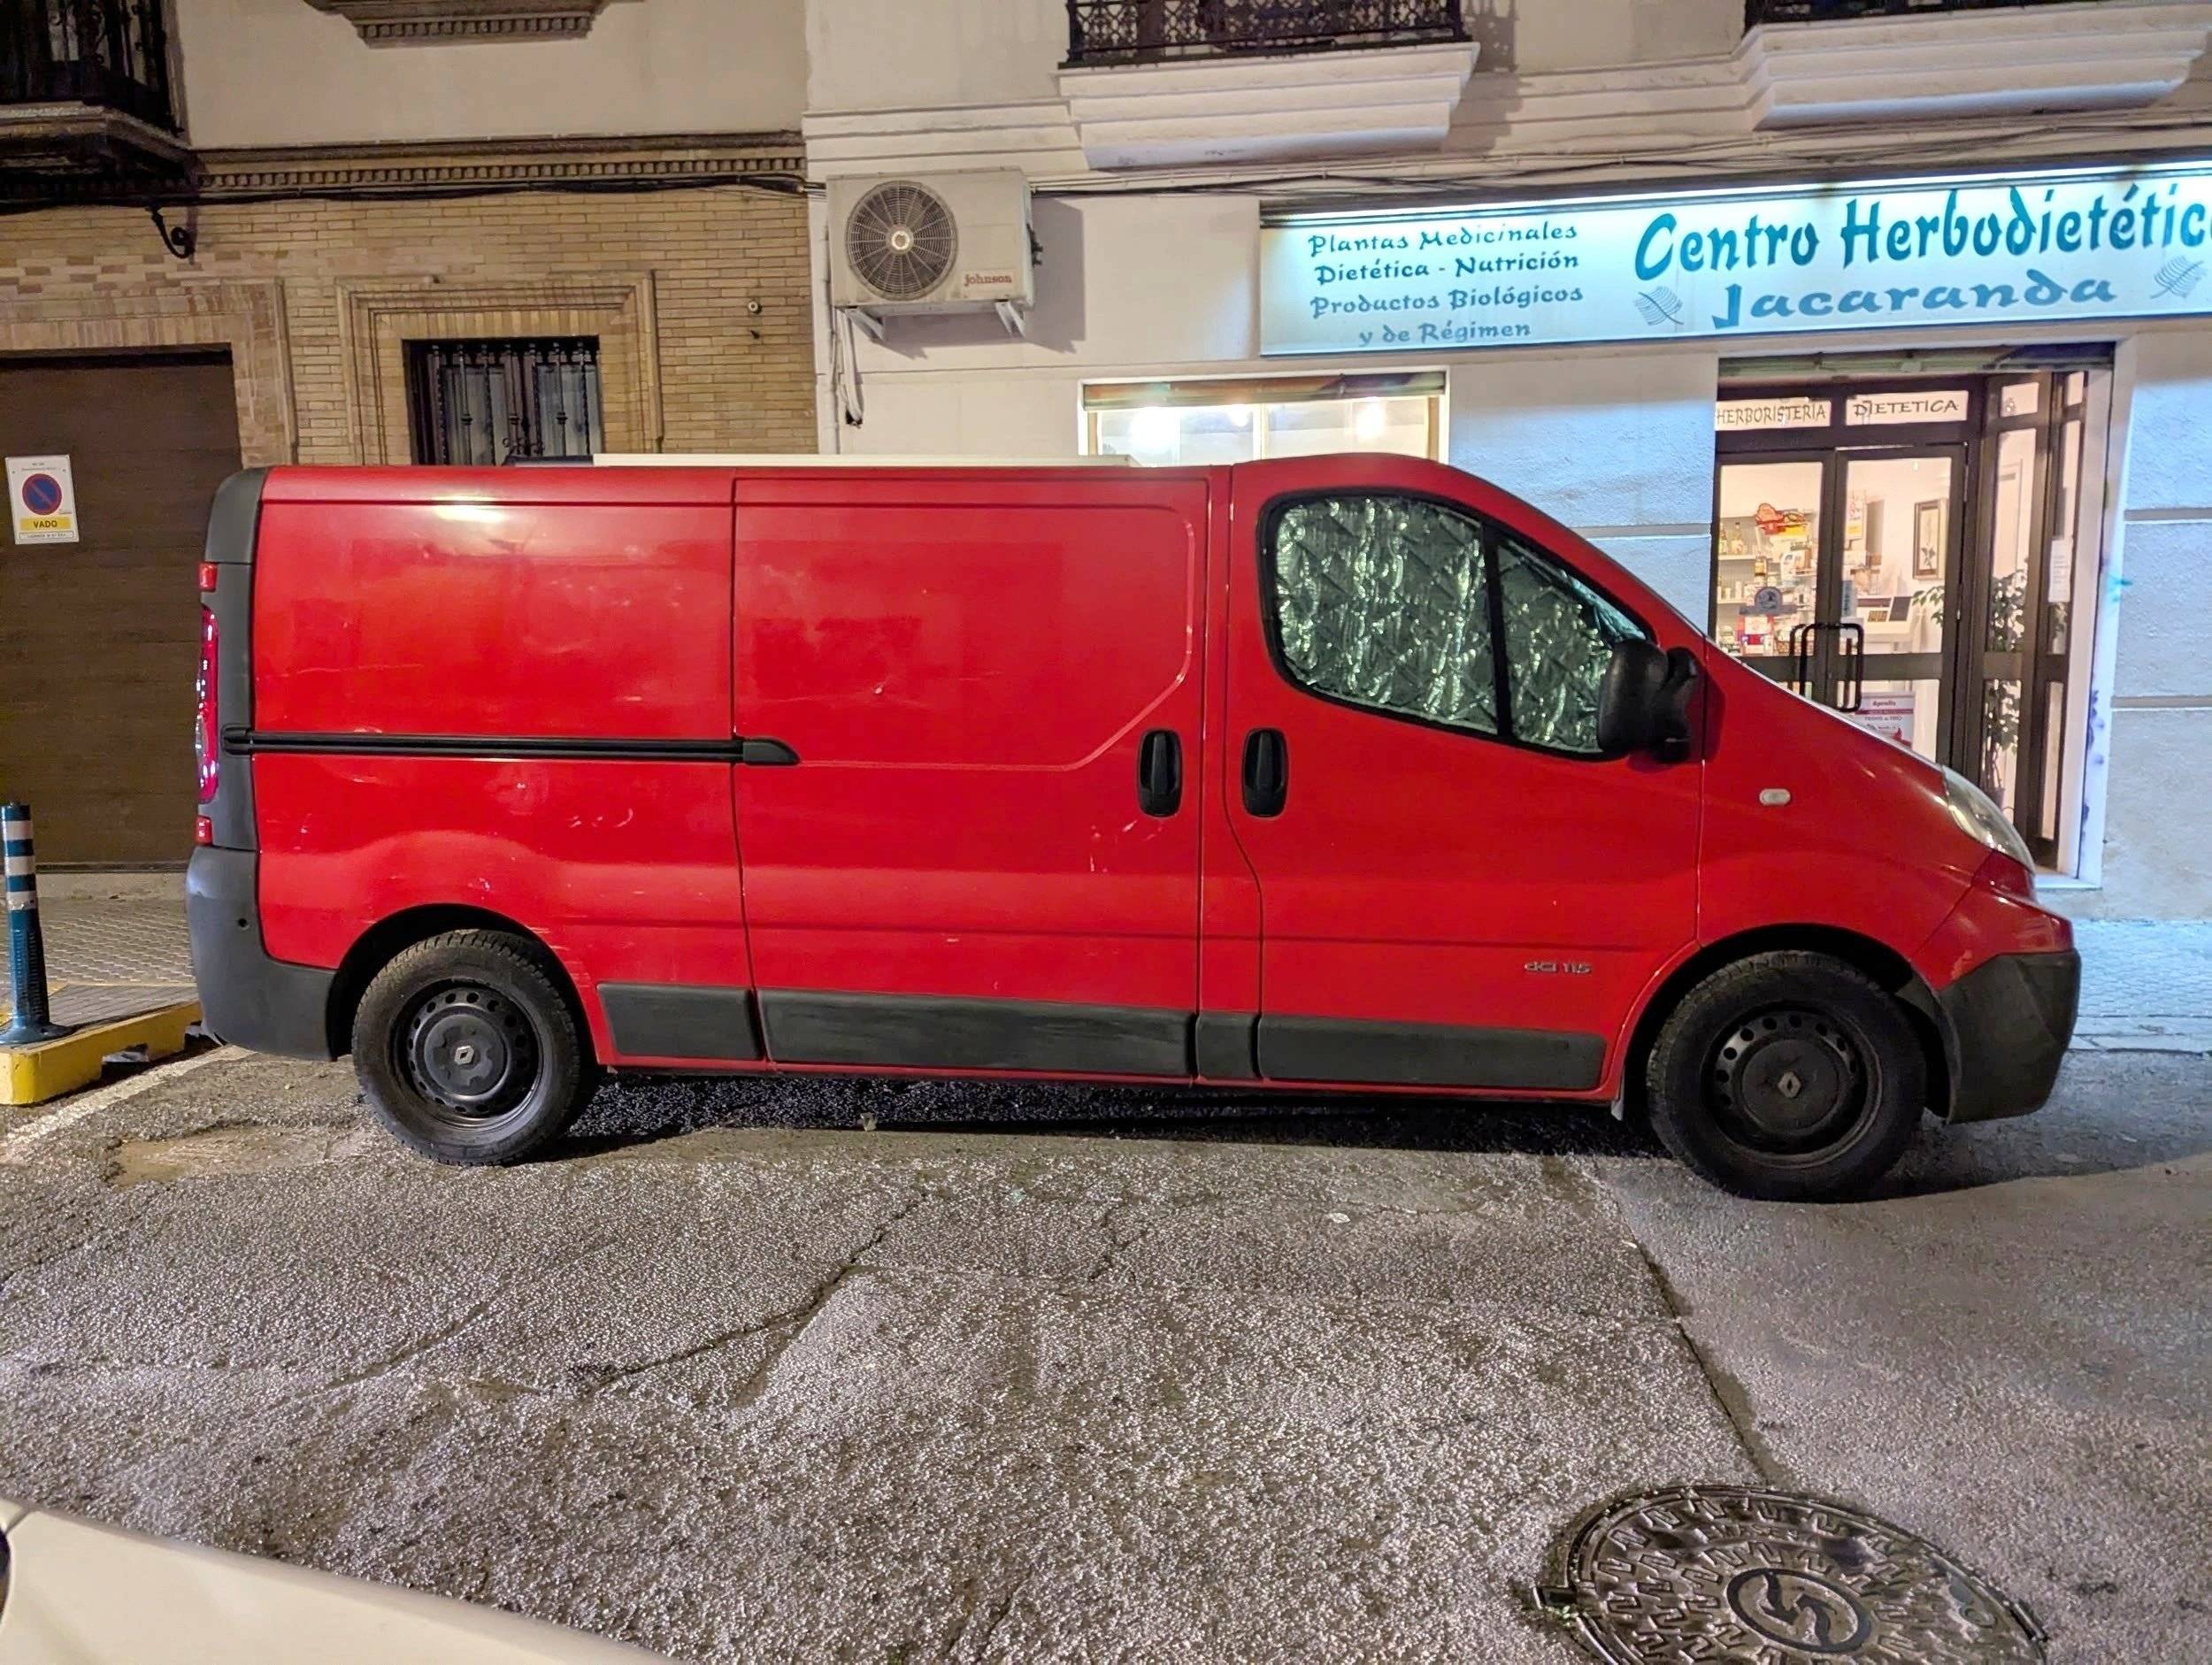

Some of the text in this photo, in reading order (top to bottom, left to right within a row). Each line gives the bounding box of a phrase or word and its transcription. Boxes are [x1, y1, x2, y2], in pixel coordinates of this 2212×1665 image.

[1308, 221, 1578, 257] Plantas Medicinales
[1634, 182, 2212, 281] Centro Herbodietétic
[1315, 258, 1430, 285] Dietética
[1455, 252, 1579, 278] Nutrición
[1310, 284, 1584, 319] Productos Biológicos
[1712, 269, 2117, 329] Jacaranda
[1359, 319, 1532, 348] y de Régimen
[1717, 403, 1826, 426] HERBORISTERIA
[1854, 399, 1959, 417] DIETETICA
[33, 519, 58, 529] VADO
